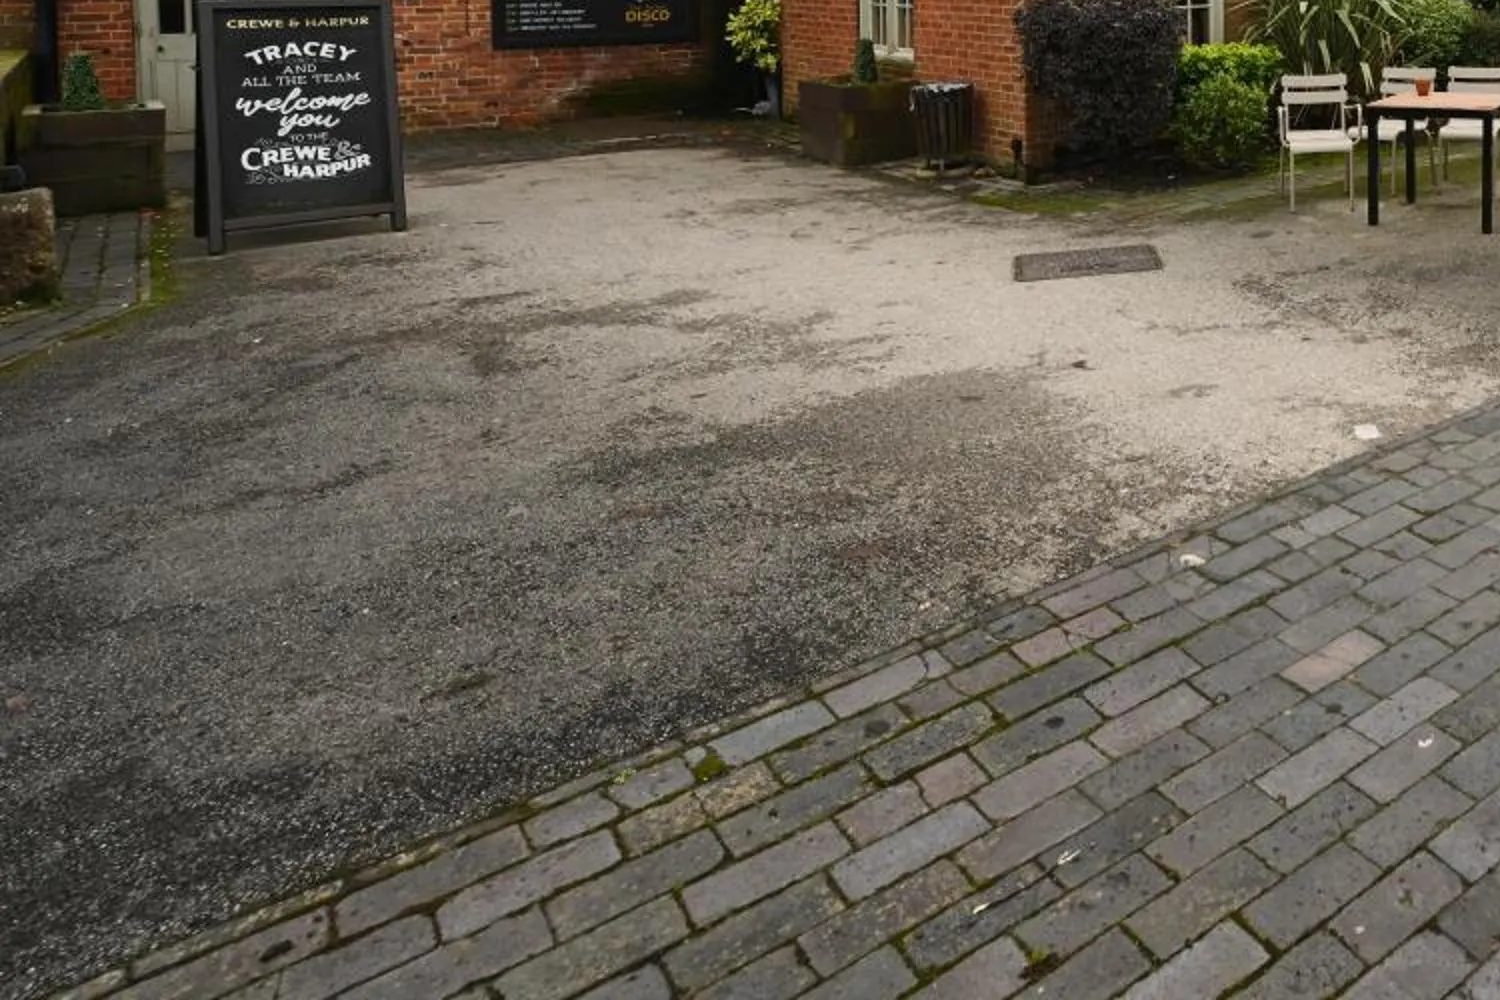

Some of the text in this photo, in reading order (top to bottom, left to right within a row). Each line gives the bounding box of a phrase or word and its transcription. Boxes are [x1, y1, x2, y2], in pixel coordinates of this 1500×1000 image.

[226, 16, 369, 29] CREWE & HARPUR
[625, 8, 671, 23] DISCO
[244, 41, 358, 65] TRACEY
[283, 63, 317, 74] AND
[241, 71, 361, 87] ALL THE TEAM
[235, 87, 371, 116] welcome
[277, 113, 340, 136] you
[290, 131, 329, 142] TO THE
[241, 147, 331, 170] CREWE
[283, 153, 371, 178] HARPUR
